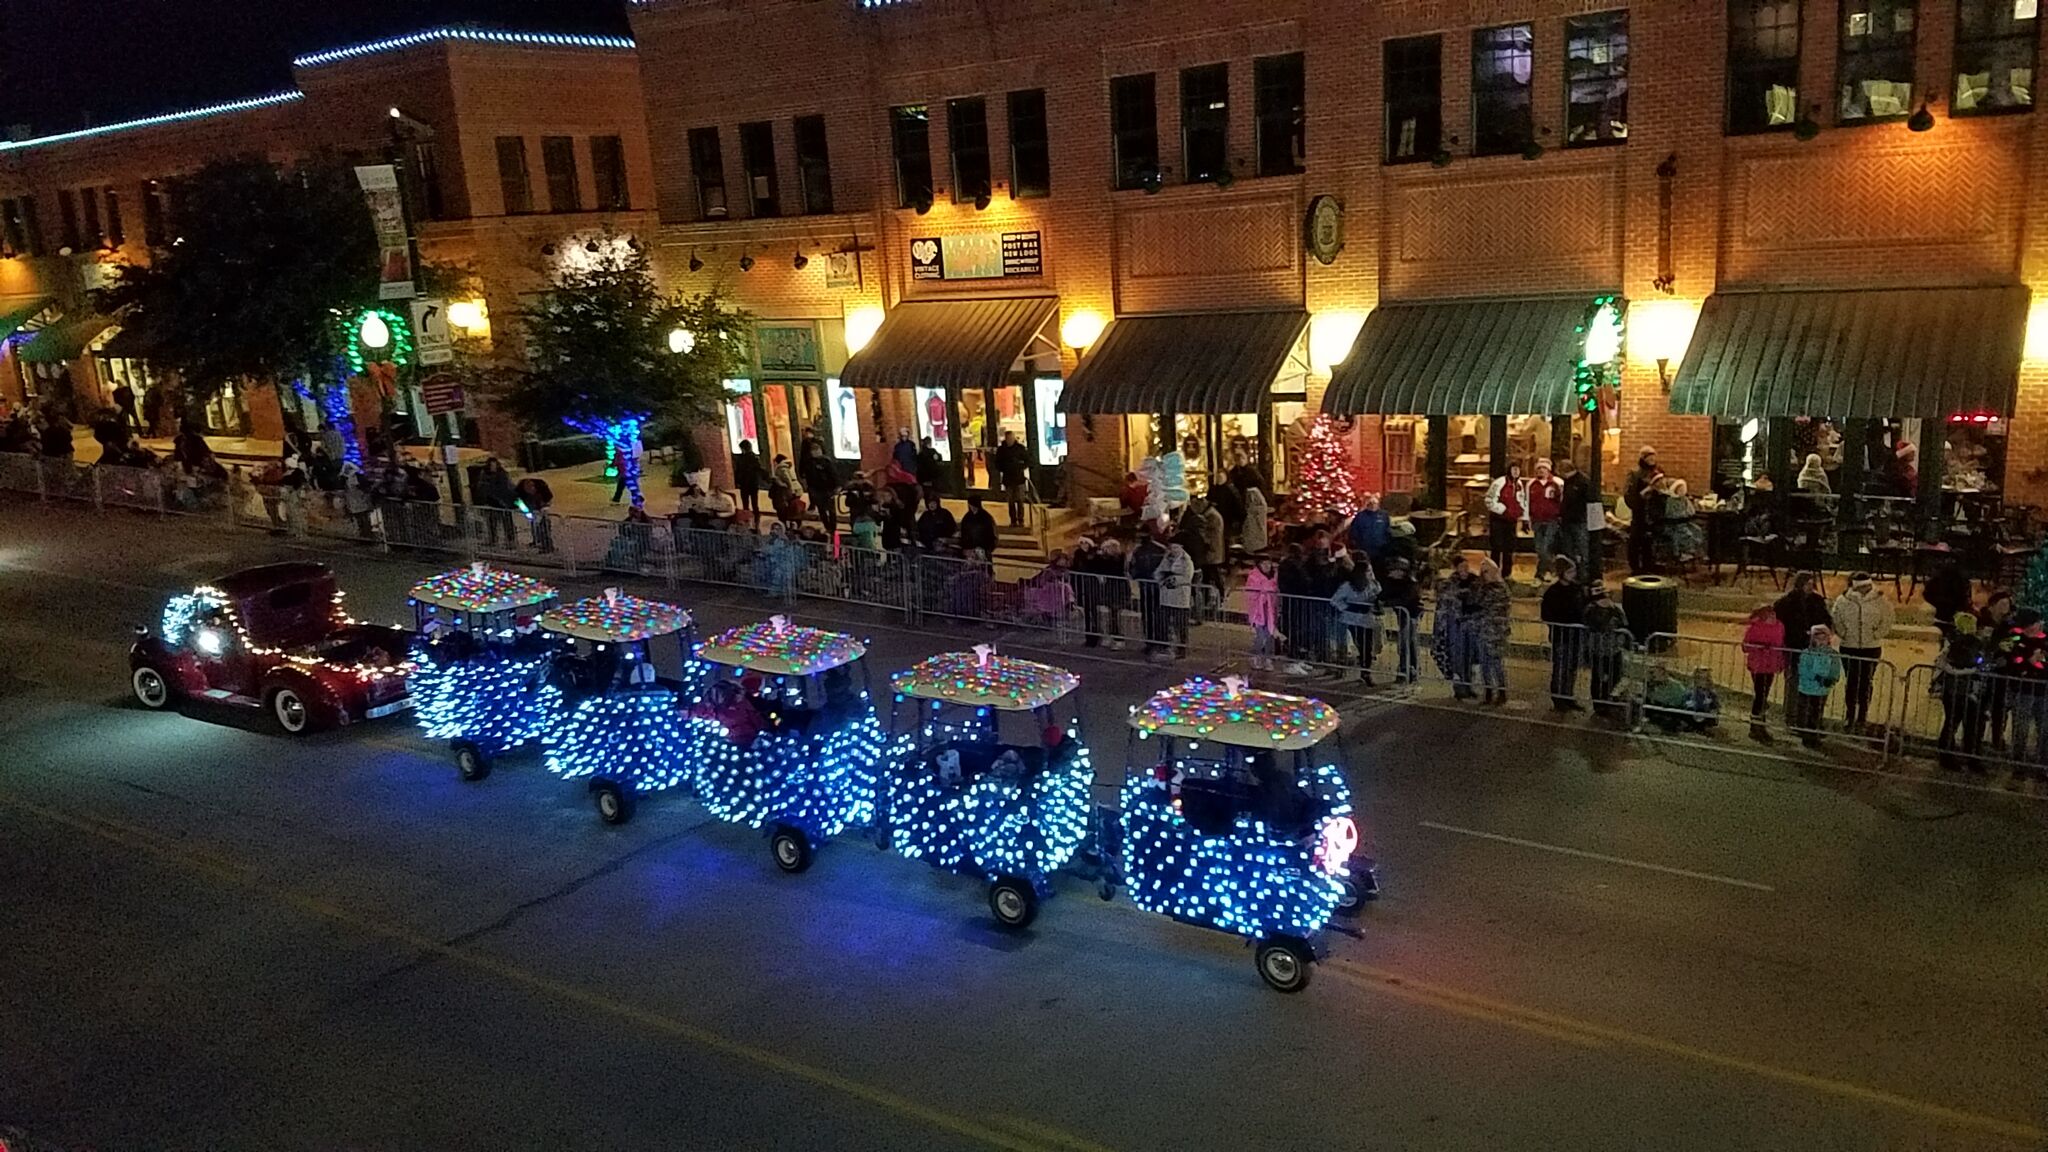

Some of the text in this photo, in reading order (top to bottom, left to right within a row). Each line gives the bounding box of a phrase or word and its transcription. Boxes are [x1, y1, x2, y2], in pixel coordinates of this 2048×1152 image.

[1003, 241, 1021, 250] POST
[1020, 249, 1039, 257] LOOK
[421, 334, 445, 345] ONLY
